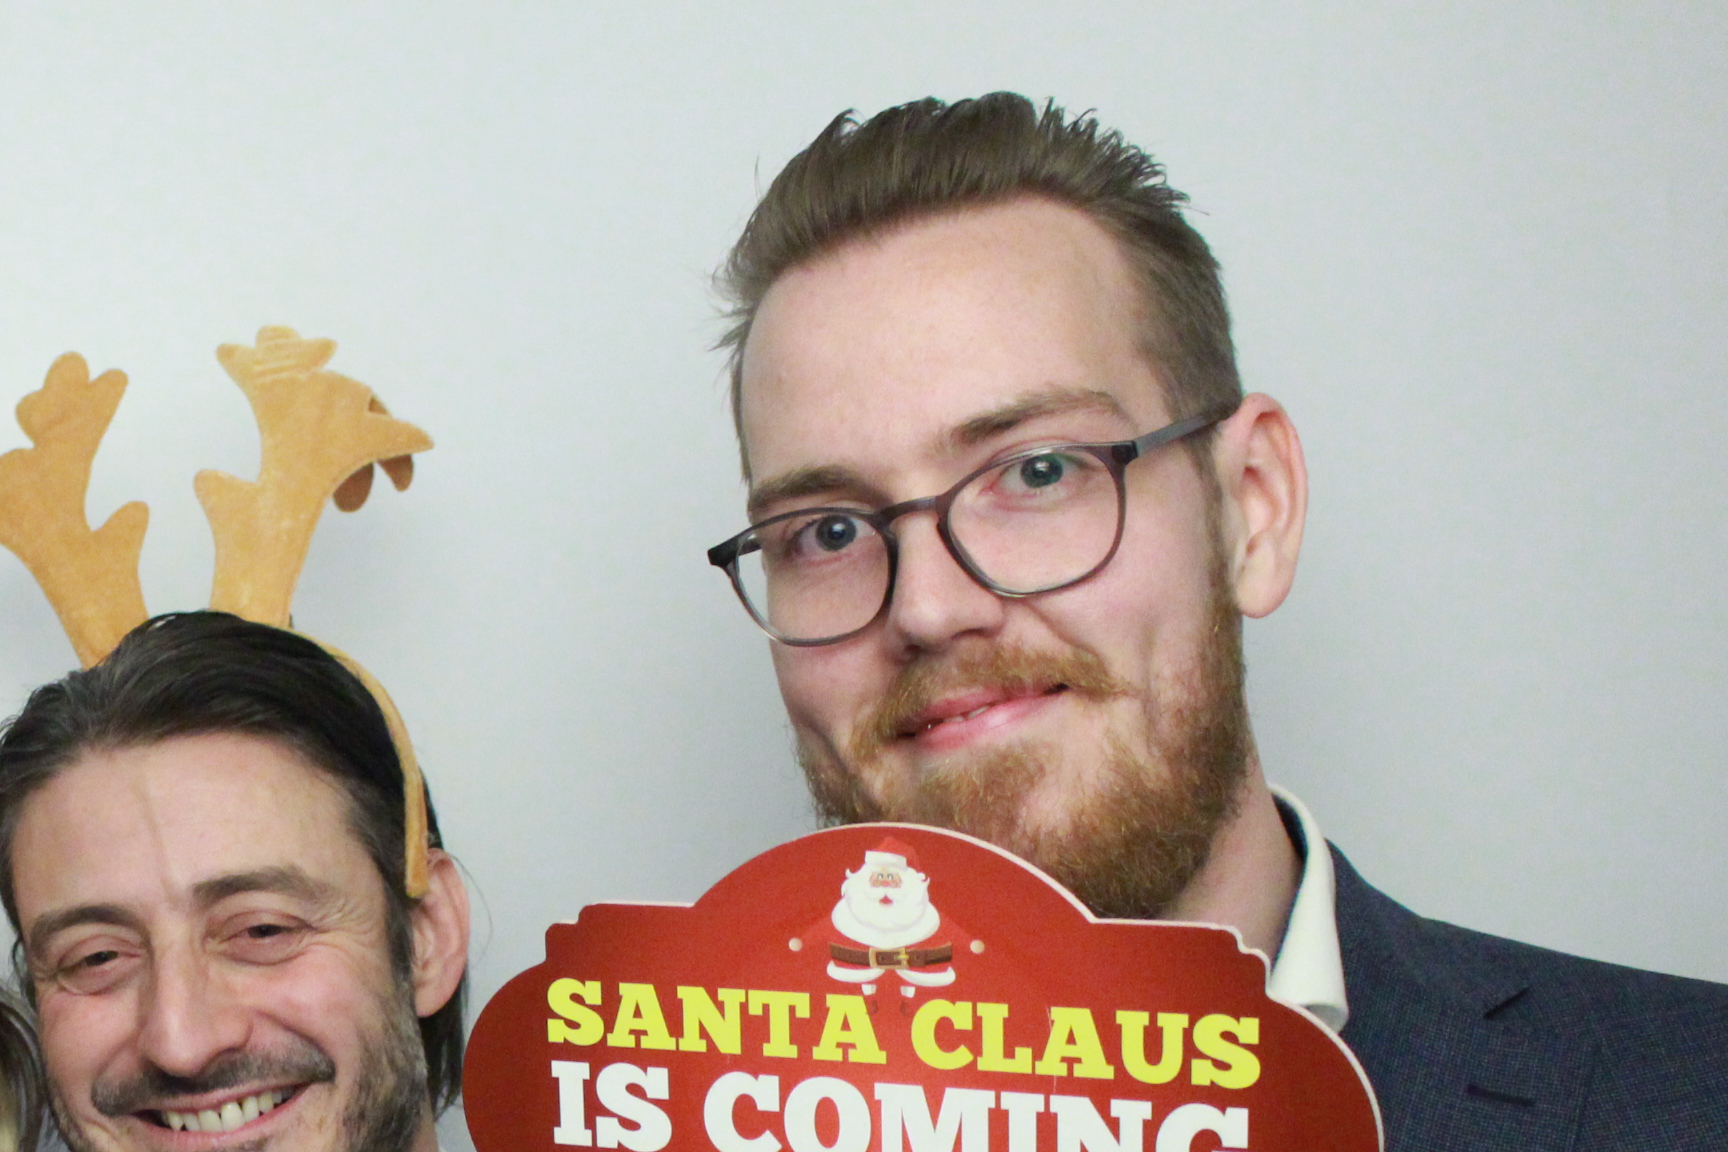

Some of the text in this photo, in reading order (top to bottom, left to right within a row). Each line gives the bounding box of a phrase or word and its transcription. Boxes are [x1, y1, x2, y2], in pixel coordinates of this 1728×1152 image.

[547, 977, 1261, 1089] SANTA CLAUS
[551, 1060, 672, 1152] IS
